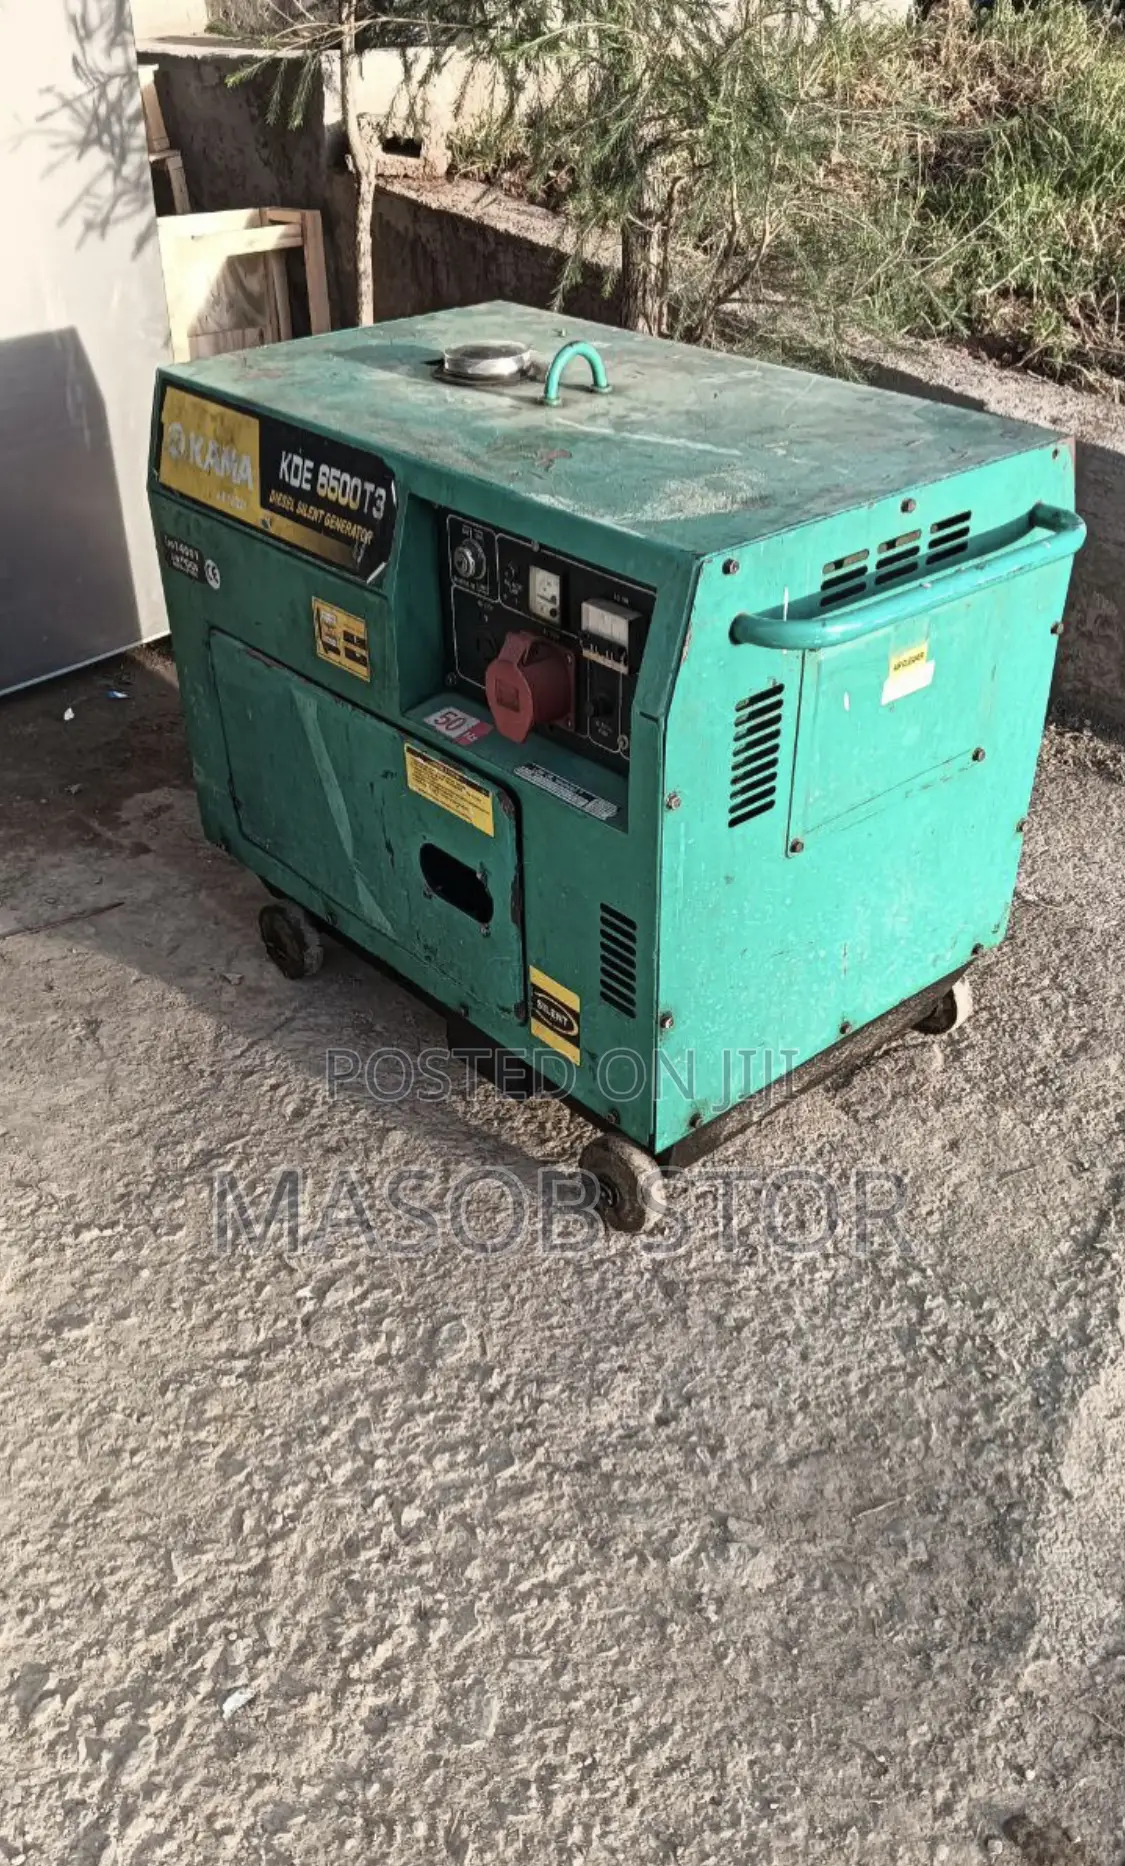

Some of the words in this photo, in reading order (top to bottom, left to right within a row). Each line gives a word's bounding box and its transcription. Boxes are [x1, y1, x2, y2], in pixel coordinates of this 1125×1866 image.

[189, 431, 253, 493] KAMA
[279, 450, 314, 491] KDE
[269, 488, 295, 512] DIESEL
[295, 500, 325, 525] SILENT
[323, 512, 374, 545] GENERATOR
[434, 710, 467, 731] 50
[536, 998, 568, 1027] SILENT
